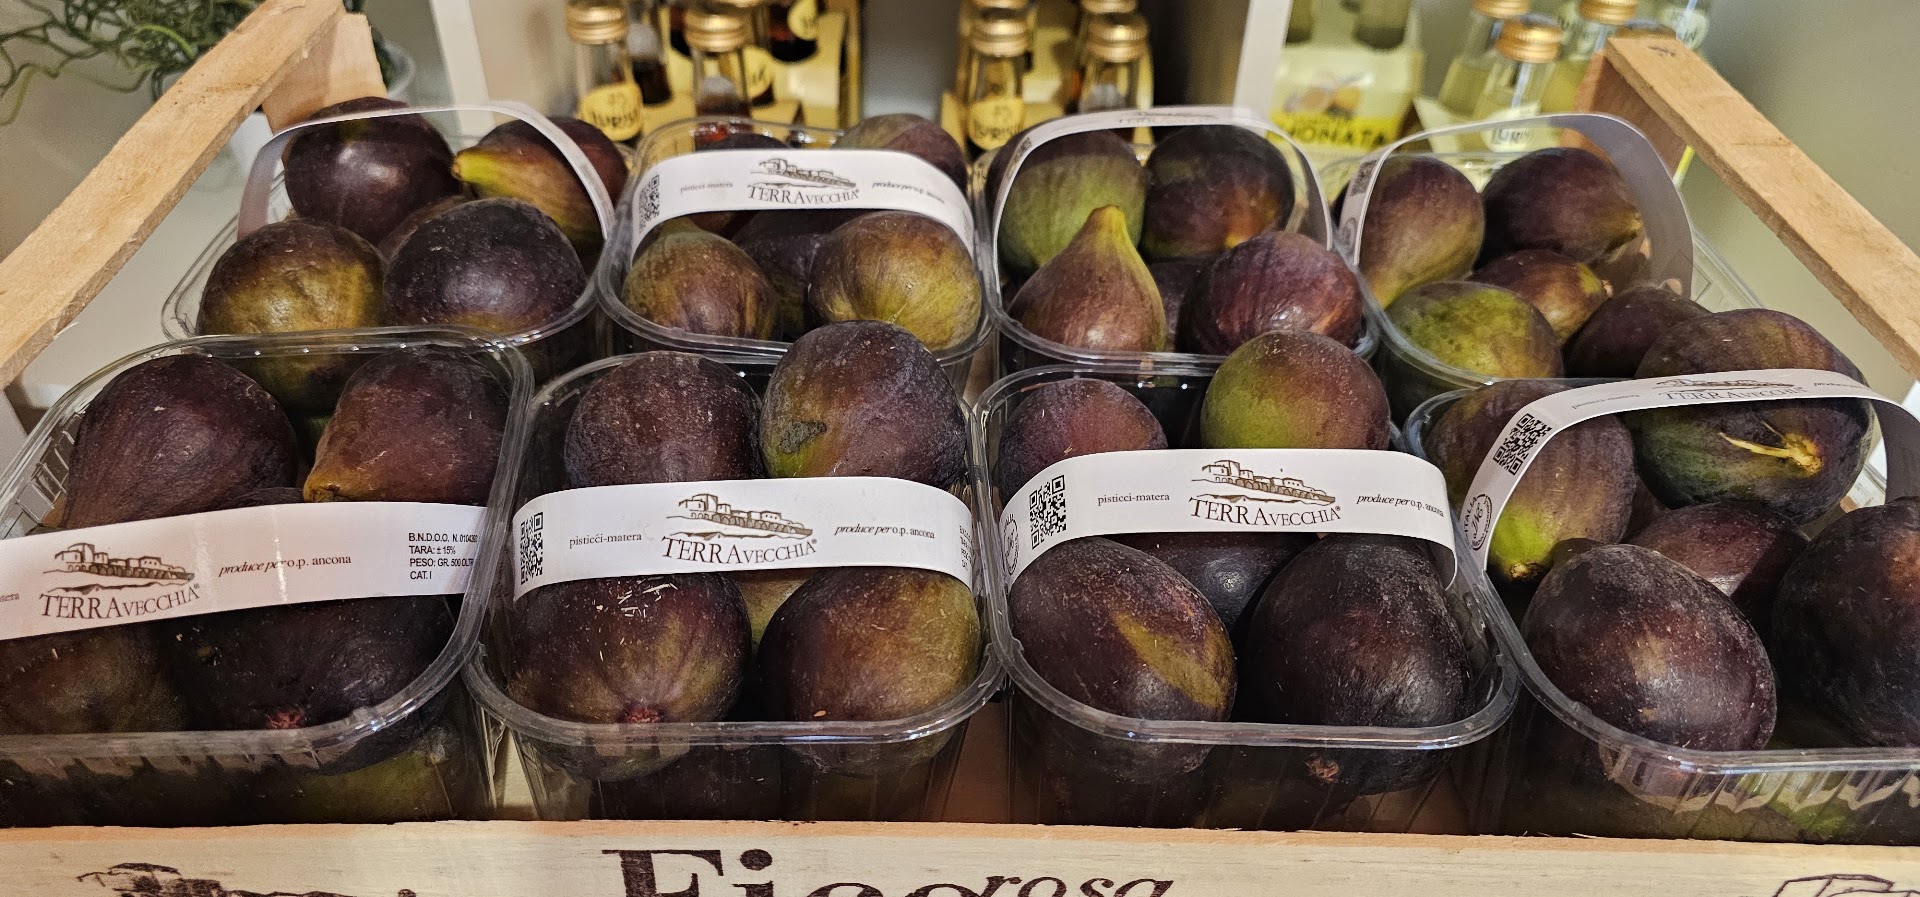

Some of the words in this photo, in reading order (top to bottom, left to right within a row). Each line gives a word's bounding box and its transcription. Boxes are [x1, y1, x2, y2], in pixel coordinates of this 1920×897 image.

[1097, 492, 1170, 506] pisticci-matera
[1356, 493, 1395, 505] produce
[1394, 497, 1410, 507] per
[834, 523, 875, 535] produce
[873, 526, 893, 535] per
[909, 529, 936, 539] ancona
[569, 532, 642, 549] pisticci-matera
[408, 545, 436, 554] TARA:
[218, 561, 264, 577] produce
[311, 556, 352, 566] ancona
[409, 558, 436, 567] PESO:
